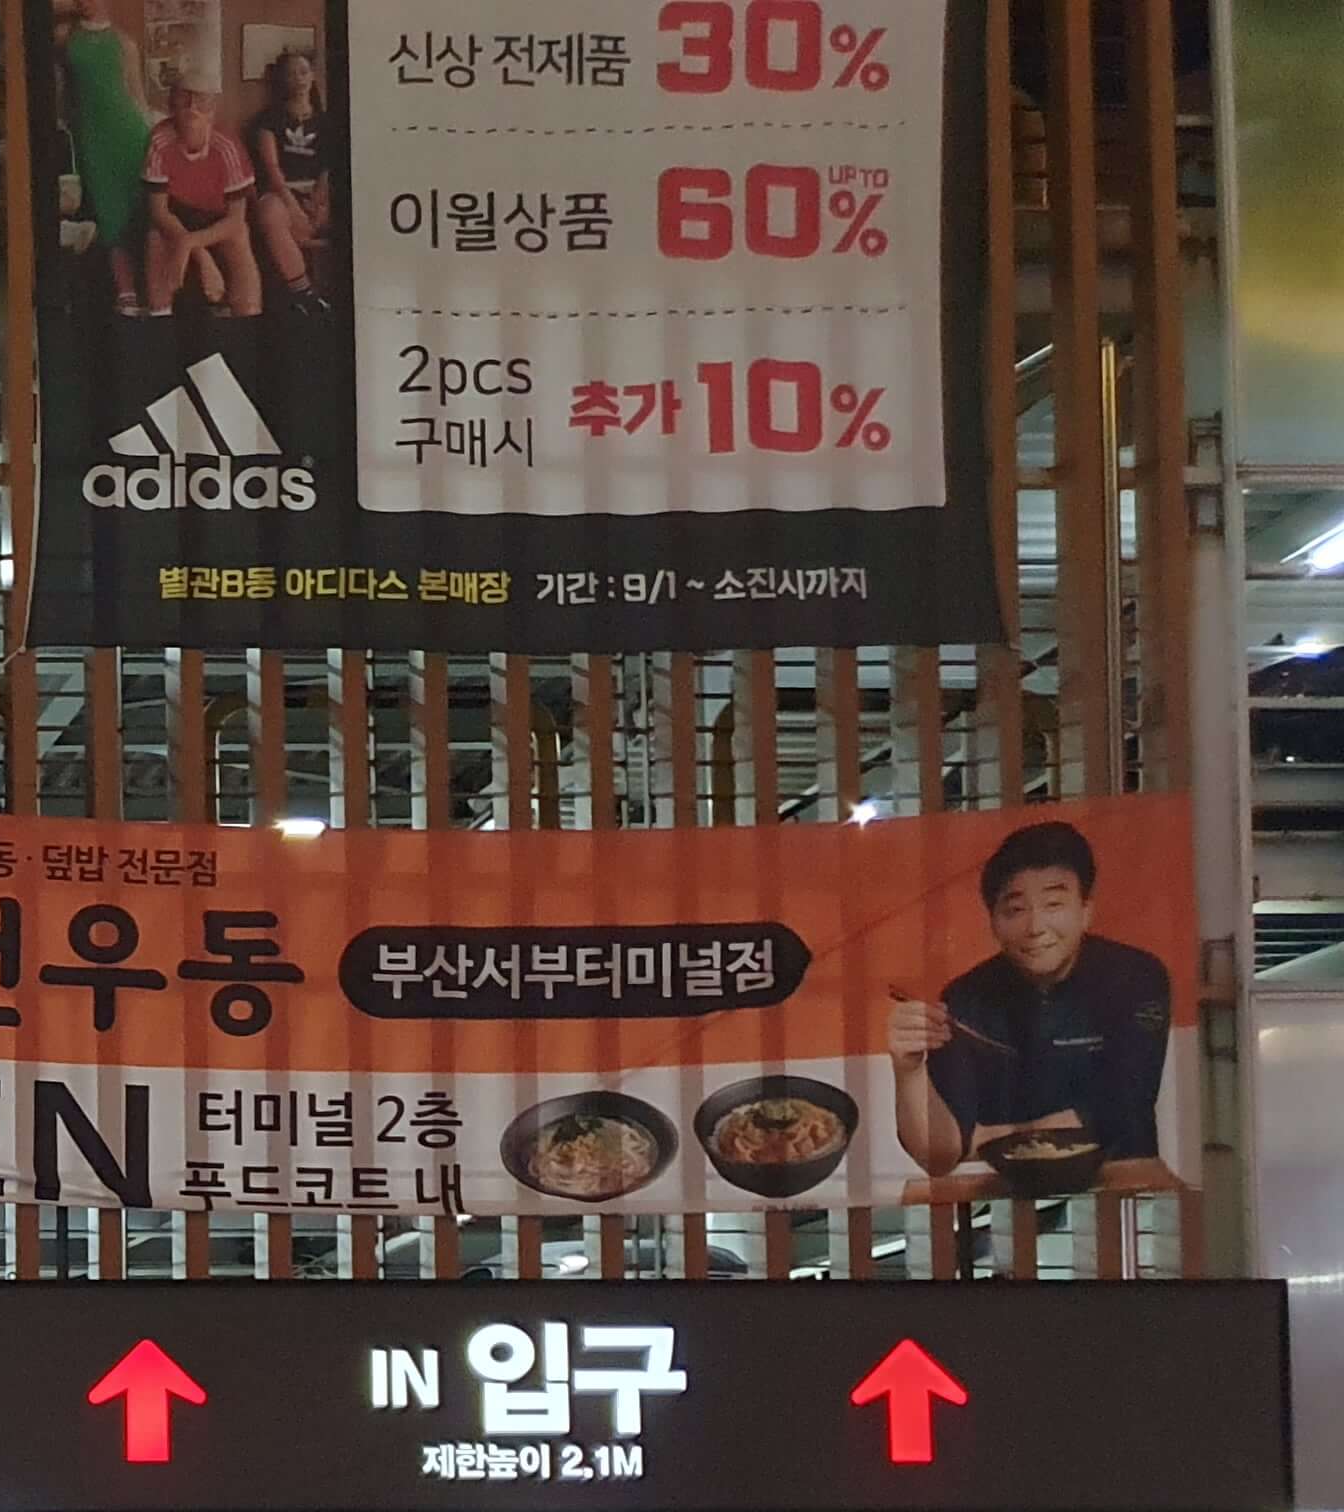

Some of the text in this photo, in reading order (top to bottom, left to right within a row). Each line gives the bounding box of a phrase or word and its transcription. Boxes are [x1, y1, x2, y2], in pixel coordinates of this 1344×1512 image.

[388, 0, 890, 93] 신상 전제품 30%
[389, 164, 889, 260] 이월상품 60%
[398, 344, 533, 403] 2pcs
[568, 358, 890, 455] 추가 10%
[395, 416, 534, 470] 구매시
[82, 453, 316, 512] adidas
[159, 566, 277, 600] 별관B동
[285, 567, 409, 600] 아디다스
[418, 567, 511, 604] 본매장
[43, 844, 109, 882] 덮밥
[117, 847, 219, 888] 전문점
[372, 937, 777, 1001] 부산서부터미널점
[198, 1089, 463, 1149] 터미널 2층
[179, 1161, 465, 1215] 푸드코트 내
[370, 1321, 688, 1435] IN 입구
[422, 1444, 550, 1480] 제한높이
